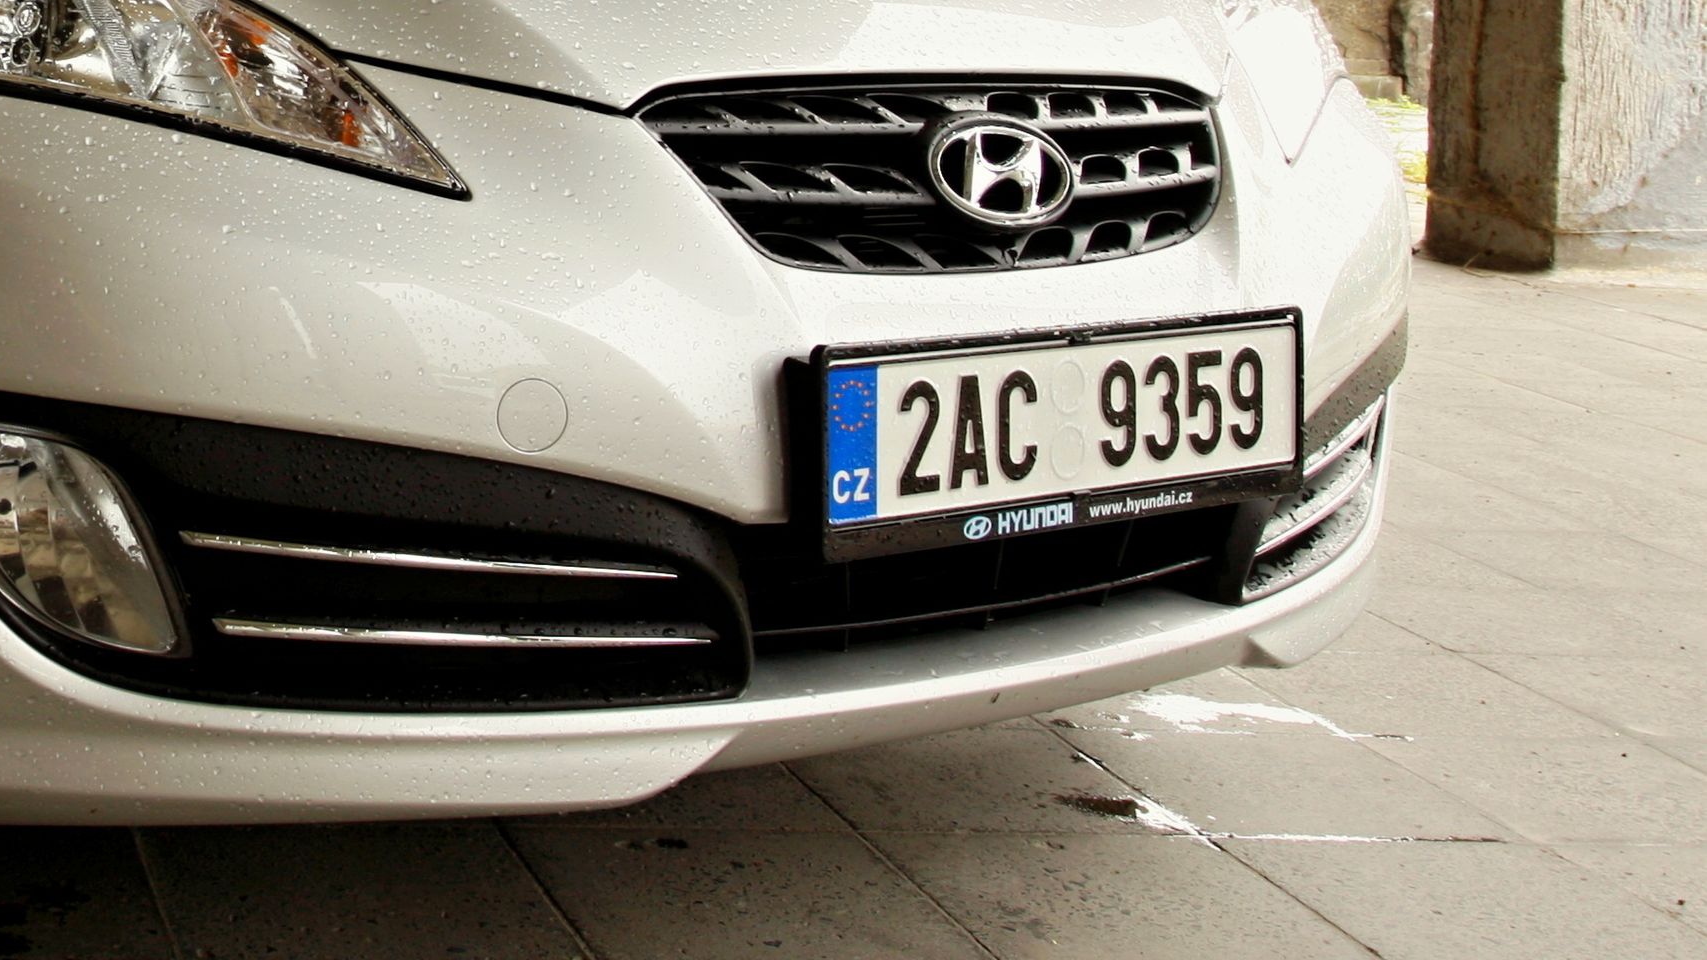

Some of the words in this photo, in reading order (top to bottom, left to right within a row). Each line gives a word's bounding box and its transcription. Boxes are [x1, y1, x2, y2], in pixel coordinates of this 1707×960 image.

[898, 370, 1039, 497] 2AC
[1099, 346, 1264, 468] 9359
[832, 469, 870, 504] CZ
[997, 502, 1074, 536] HYUNDAI
[1088, 490, 1194, 519] www.hyundai.cz
